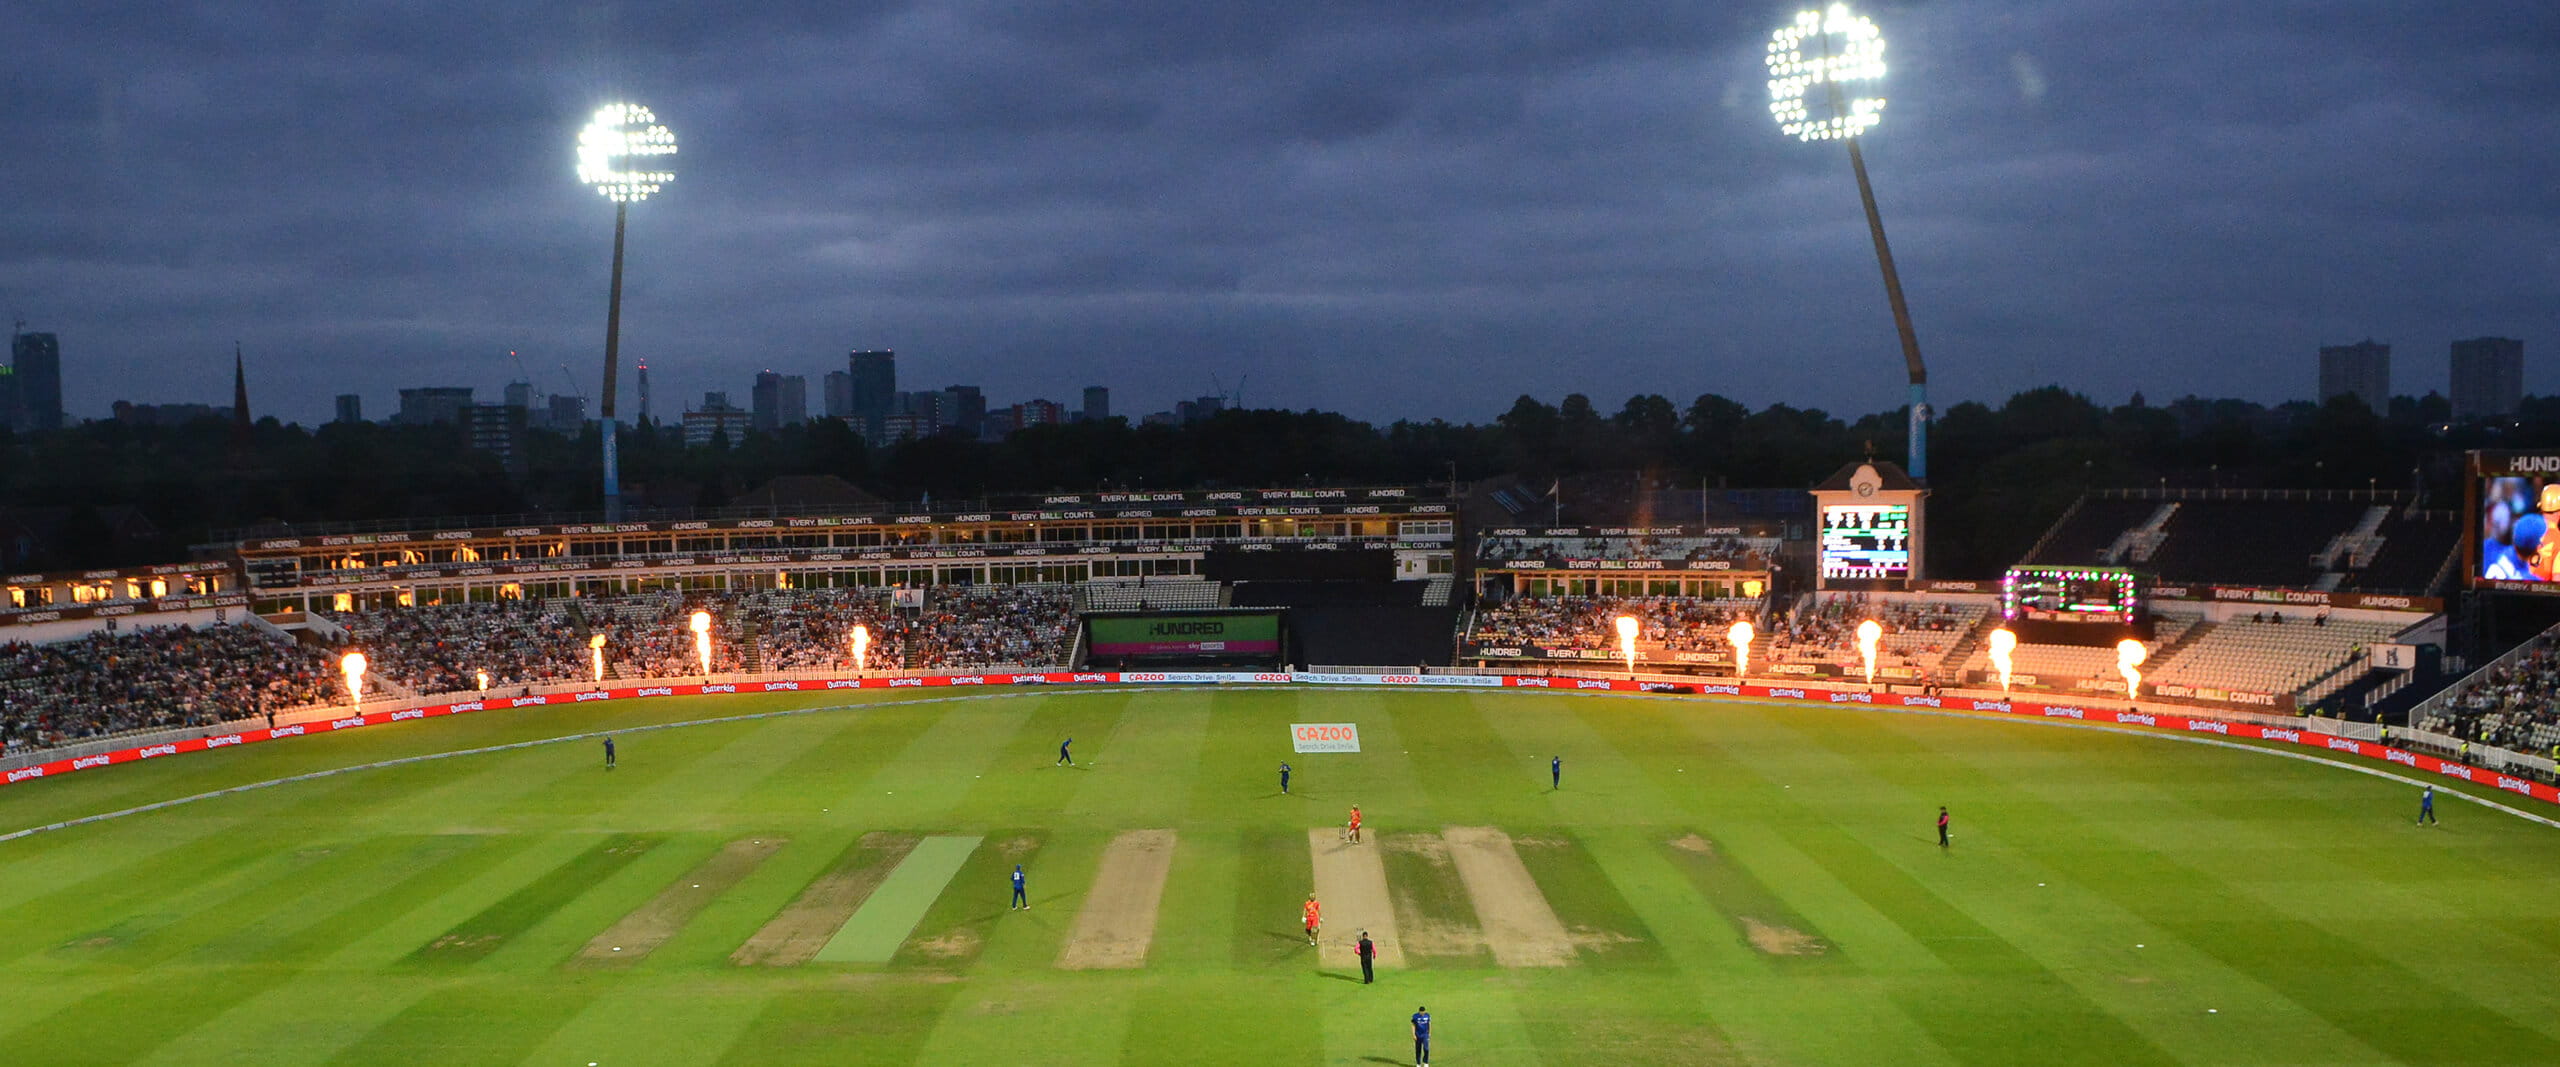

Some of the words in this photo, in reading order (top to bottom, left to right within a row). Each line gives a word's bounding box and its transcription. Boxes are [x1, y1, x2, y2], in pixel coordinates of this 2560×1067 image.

[1045, 496, 1080, 504] HUNDRED
[1410, 505, 1446, 513] HUNDRED
[956, 514, 990, 522] HUNDRED
[738, 520, 773, 528] HUNDRED
[503, 528, 540, 536] HUNDRED
[261, 540, 300, 548] HUNDRED
[1079, 546, 1110, 554] HUNDRED
[662, 558, 694, 566] HUNDRED
[1689, 561, 1730, 569] HUNDRED
[407, 570, 440, 578] HUNDRED
[459, 568, 492, 576] HUNDRED
[2216, 590, 2251, 599] EVERY.
[2253, 591, 2284, 601] BALL.
[2286, 593, 2331, 603] COUNTS.
[2360, 598, 2410, 608] HUNDRED
[1151, 622, 1224, 635] HUNDRED
[1480, 648, 1521, 656] HUNDRED
[1547, 650, 1579, 658] EVERY.
[1581, 650, 1607, 658] BALL.
[1609, 652, 1648, 660] COUTS.
[1675, 653, 1719, 661] HUNDRED
[1769, 665, 1816, 674] HUNDRED
[1381, 675, 1418, 683] CAZOO
[1986, 674, 2037, 685] HUDRED
[1297, 727, 1353, 740] CAZOO
